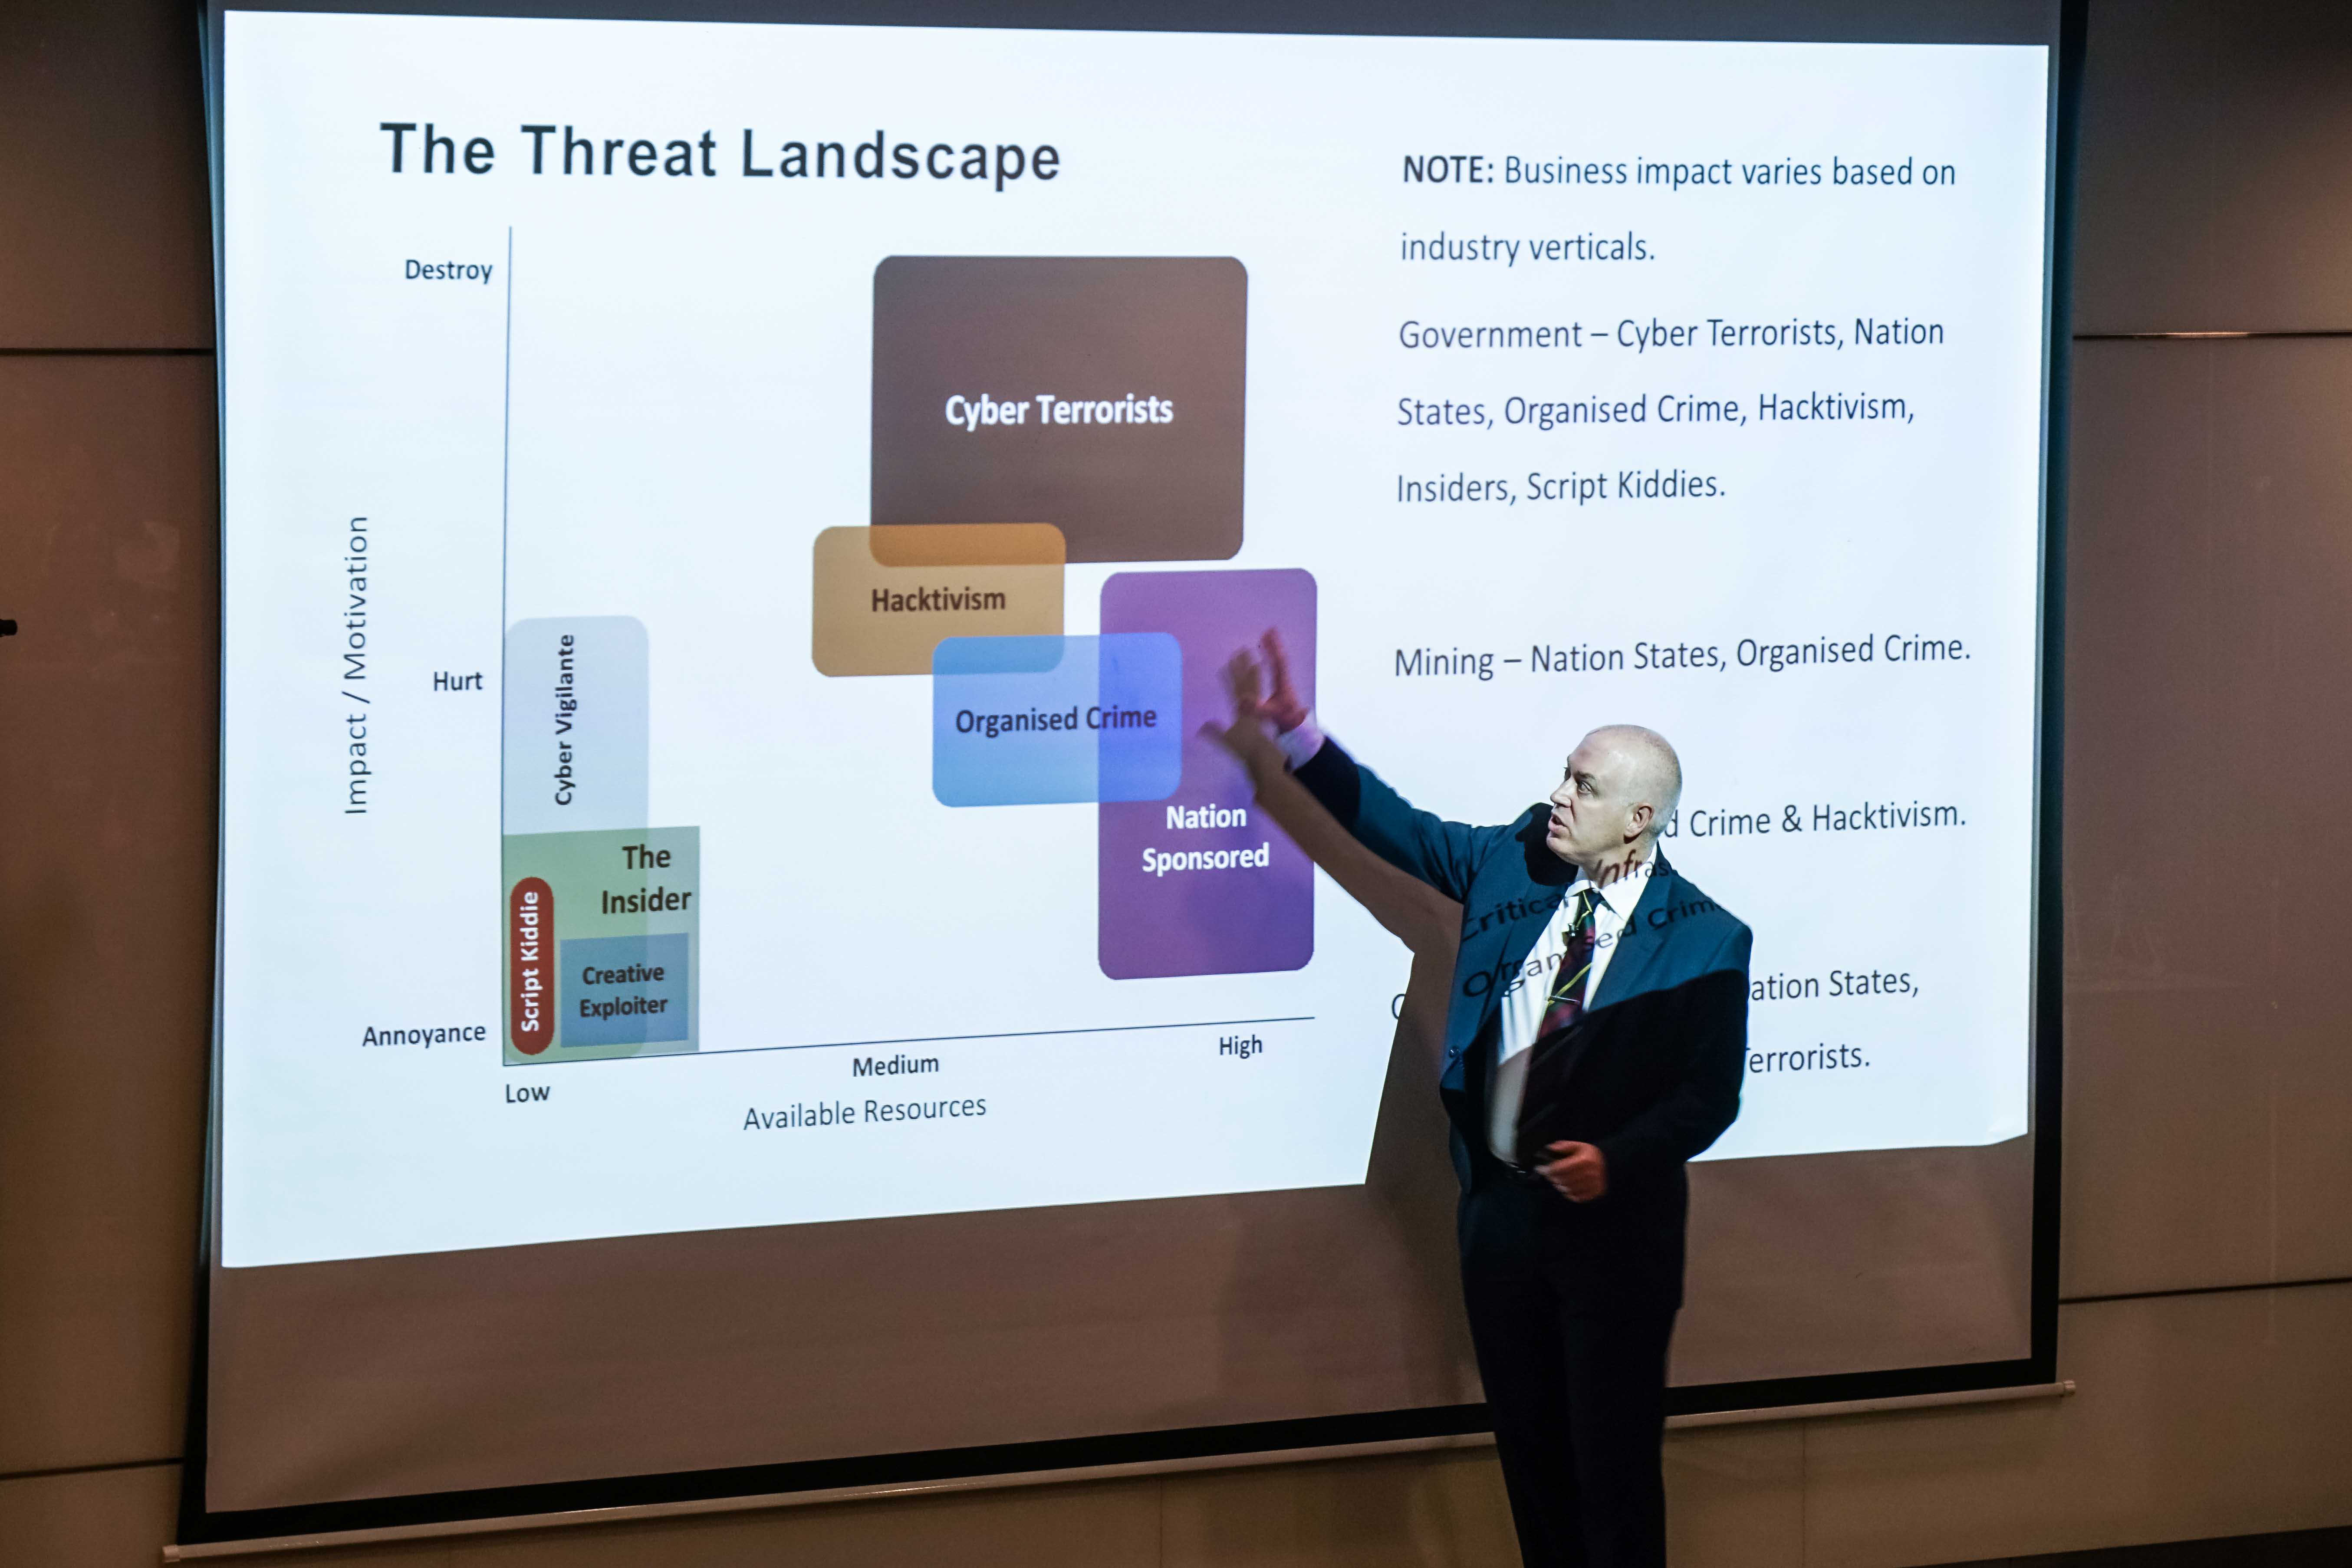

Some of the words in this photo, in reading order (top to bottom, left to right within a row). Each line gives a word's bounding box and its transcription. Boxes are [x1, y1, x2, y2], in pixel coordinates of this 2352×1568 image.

[380, 122, 494, 174] The
[521, 125, 716, 177] Threat
[743, 129, 1059, 192] Landscape
[1404, 155, 1493, 183] NOTE:
[1506, 155, 1627, 184] Business
[1638, 159, 1732, 191] impact
[1742, 158, 1822, 185] varies
[1833, 156, 1912, 185] based
[1923, 165, 1955, 185] on
[1402, 231, 1520, 267] industry
[1529, 231, 1655, 260] verticals.
[405, 259, 493, 285] Destroy
[1399, 320, 1582, 348] Government
[1617, 317, 1698, 354] Cyber
[1707, 318, 1843, 350] Terrorists,
[1855, 318, 1943, 345] Nation
[946, 393, 1030, 432] Cyber
[1036, 393, 1174, 424] Terrorists
[1398, 398, 1493, 430] States,
[1505, 393, 1646, 431] Organised
[1658, 394, 1747, 426] Crime,
[1760, 391, 1914, 424] Hacktivism,
[1398, 472, 1516, 506] Insiders,
[1527, 471, 1608, 506] Script
[1618, 469, 1725, 498] Kiddies.
[343, 517, 367, 680] Motivation
[872, 586, 1006, 612] Hacktivism
[1395, 647, 1494, 681] Mining
[1532, 644, 1623, 672] Nation
[1634, 642, 1726, 672] States,
[1737, 633, 1873, 673] Organised
[1885, 634, 1970, 662] Crime.
[341, 690, 371, 704] /
[434, 671, 483, 691] Hurt
[555, 634, 577, 735] Vigilante
[956, 706, 1078, 739] Organised
[1086, 705, 1156, 730] Crime
[345, 714, 372, 814] Impact
[554, 741, 576, 805] Cyber
[1167, 803, 1247, 829] Nation
[1690, 809, 1770, 837] Crime
[1782, 804, 1803, 832] &
[1813, 800, 1965, 831] Hacktivism.
[622, 844, 671, 870] The
[1142, 842, 1269, 877] Sponsored
[602, 886, 692, 914] Insider
[1647, 899, 1715, 930] Crim
[520, 892, 539, 961] Kiddie
[582, 963, 664, 985] Creative
[1752, 973, 1819, 1001] ation
[1829, 970, 1918, 997] States,
[520, 968, 543, 1032] Script
[580, 996, 668, 1021] Exploiter
[362, 1026, 486, 1049] Annoyance
[1220, 1034, 1263, 1059] High
[853, 1054, 939, 1077] Medium
[1746, 1043, 1869, 1073] errorists.
[506, 1084, 550, 1104] Low
[743, 1101, 855, 1131] Available
[865, 1098, 986, 1122] Resources
